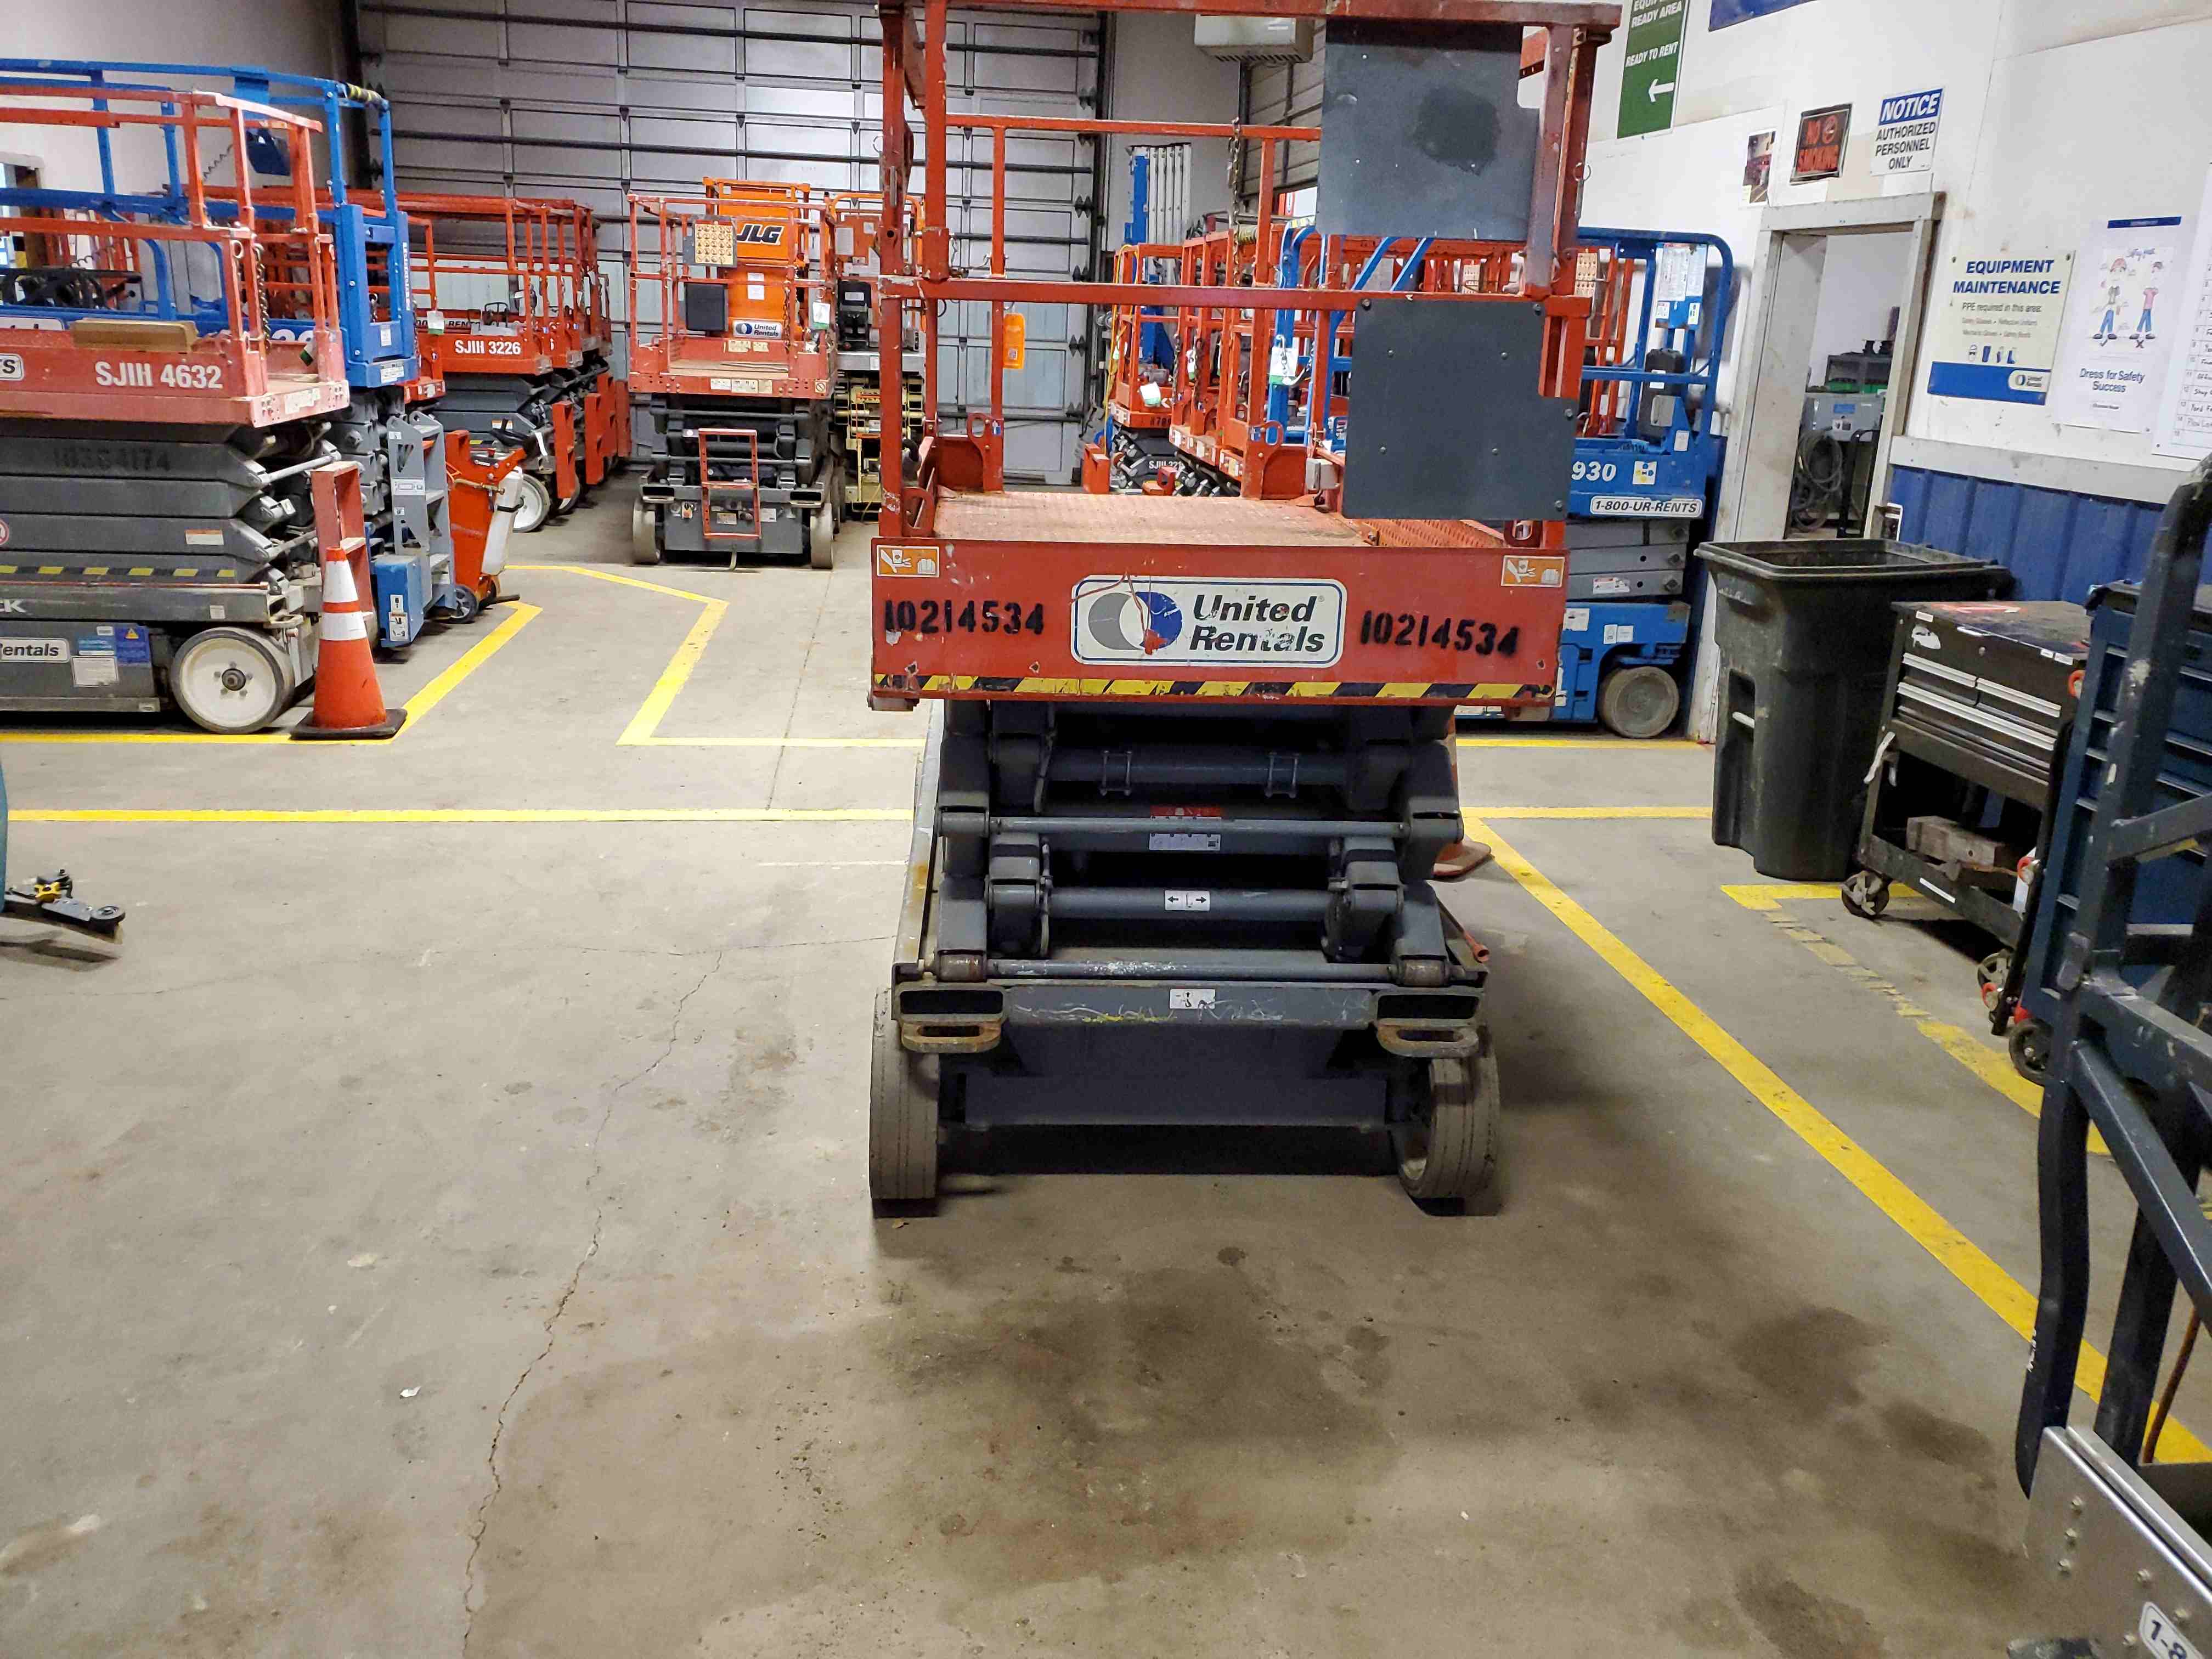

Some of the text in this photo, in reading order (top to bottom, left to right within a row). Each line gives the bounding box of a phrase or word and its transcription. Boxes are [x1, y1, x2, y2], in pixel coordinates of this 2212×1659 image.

[1632, 1, 1682, 28] READY AREA
[1626, 41, 1679, 67] READY TO RENT
[1880, 93, 1940, 122] NOTICE
[1875, 122, 1936, 141] AUTHORIZED
[1875, 138, 1930, 156] PERSONNEL
[1889, 155, 1913, 170] ONLY
[736, 224, 783, 244] JLG
[1966, 260, 2054, 274] EQUIPMENT
[1953, 281, 2061, 294] MAINTENANCE
[1962, 302, 1975, 311] PPE
[488, 341, 521, 354] 3226
[160, 364, 223, 388] 4632
[2079, 368, 2146, 383] Dress for Safety
[2092, 381, 2126, 392] Success
[1595, 500, 1697, 514] 1-800-UR-RENTS
[1193, 594, 1317, 622] United
[884, 600, 1045, 635] 10214534
[1189, 624, 1325, 652] Rentals
[1361, 610, 1520, 657] 10214534
[0, 642, 59, 657] entals
